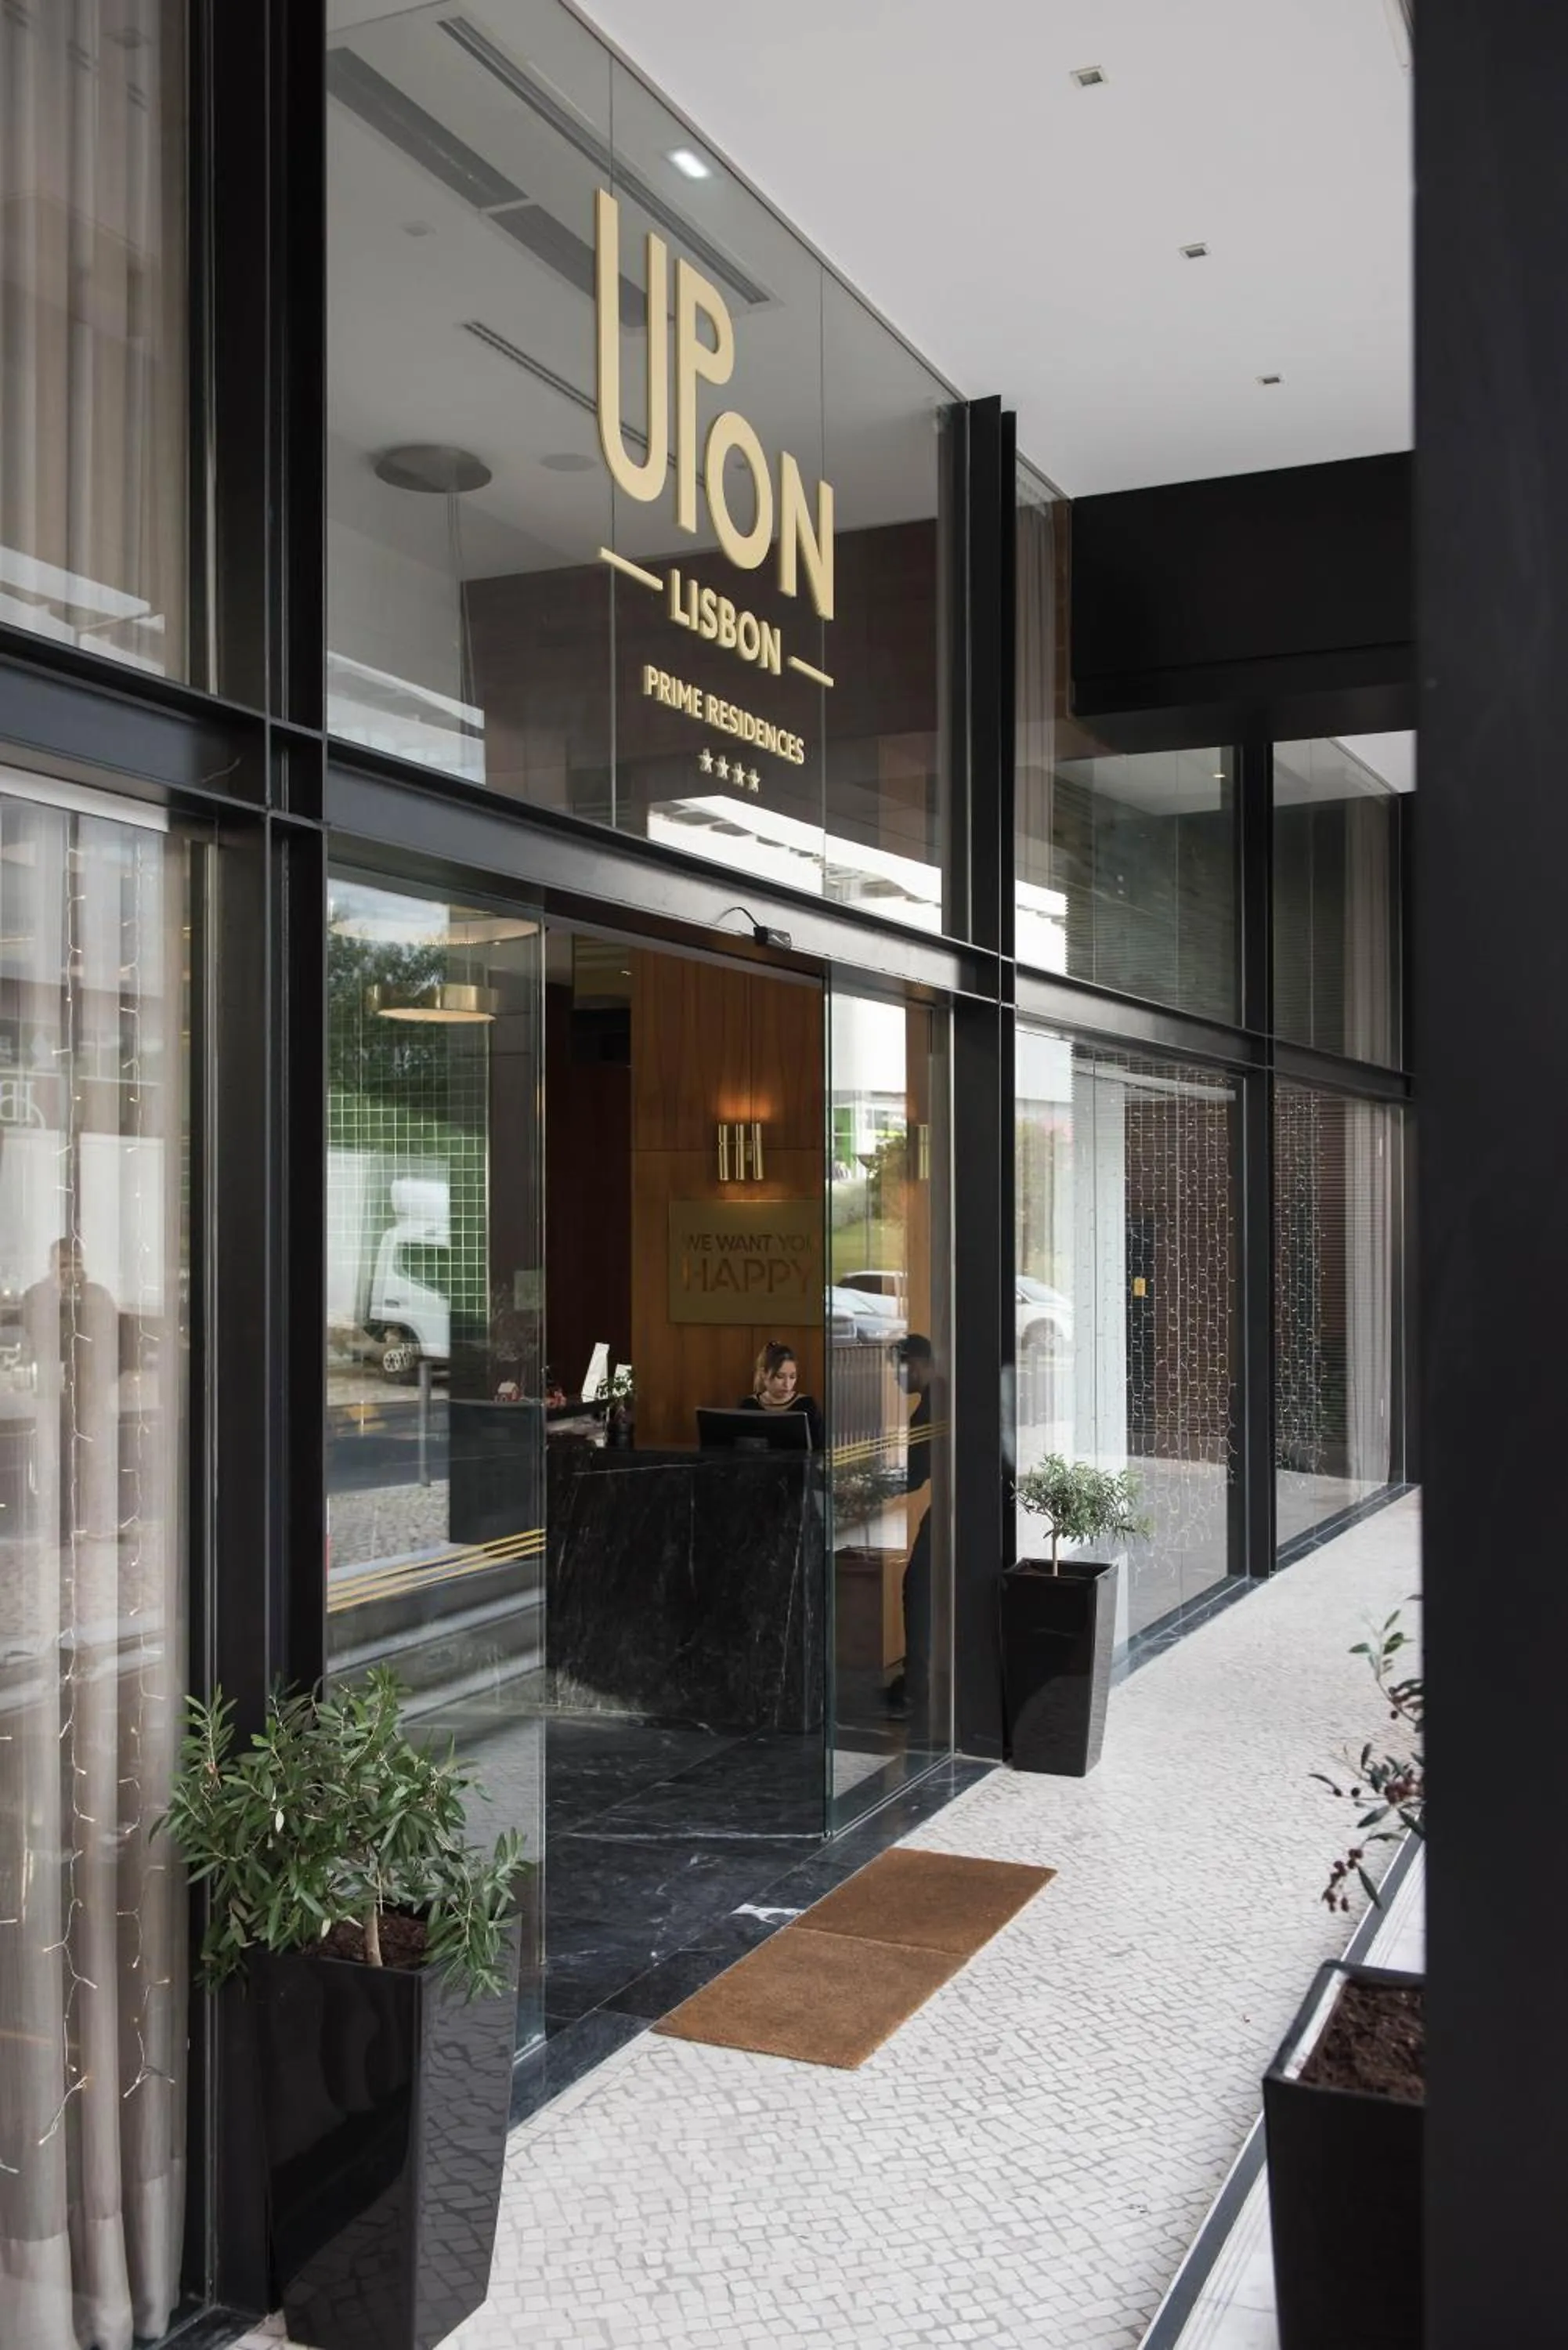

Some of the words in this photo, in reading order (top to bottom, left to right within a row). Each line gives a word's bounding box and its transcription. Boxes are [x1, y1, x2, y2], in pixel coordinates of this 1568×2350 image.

[670, 569, 782, 675] LISBON
[643, 664, 703, 718] PRIME
[704, 694, 804, 765] RESIDENCES
[684, 1257, 815, 1293] HAPPY
[715, 1234, 774, 1252] WANT
